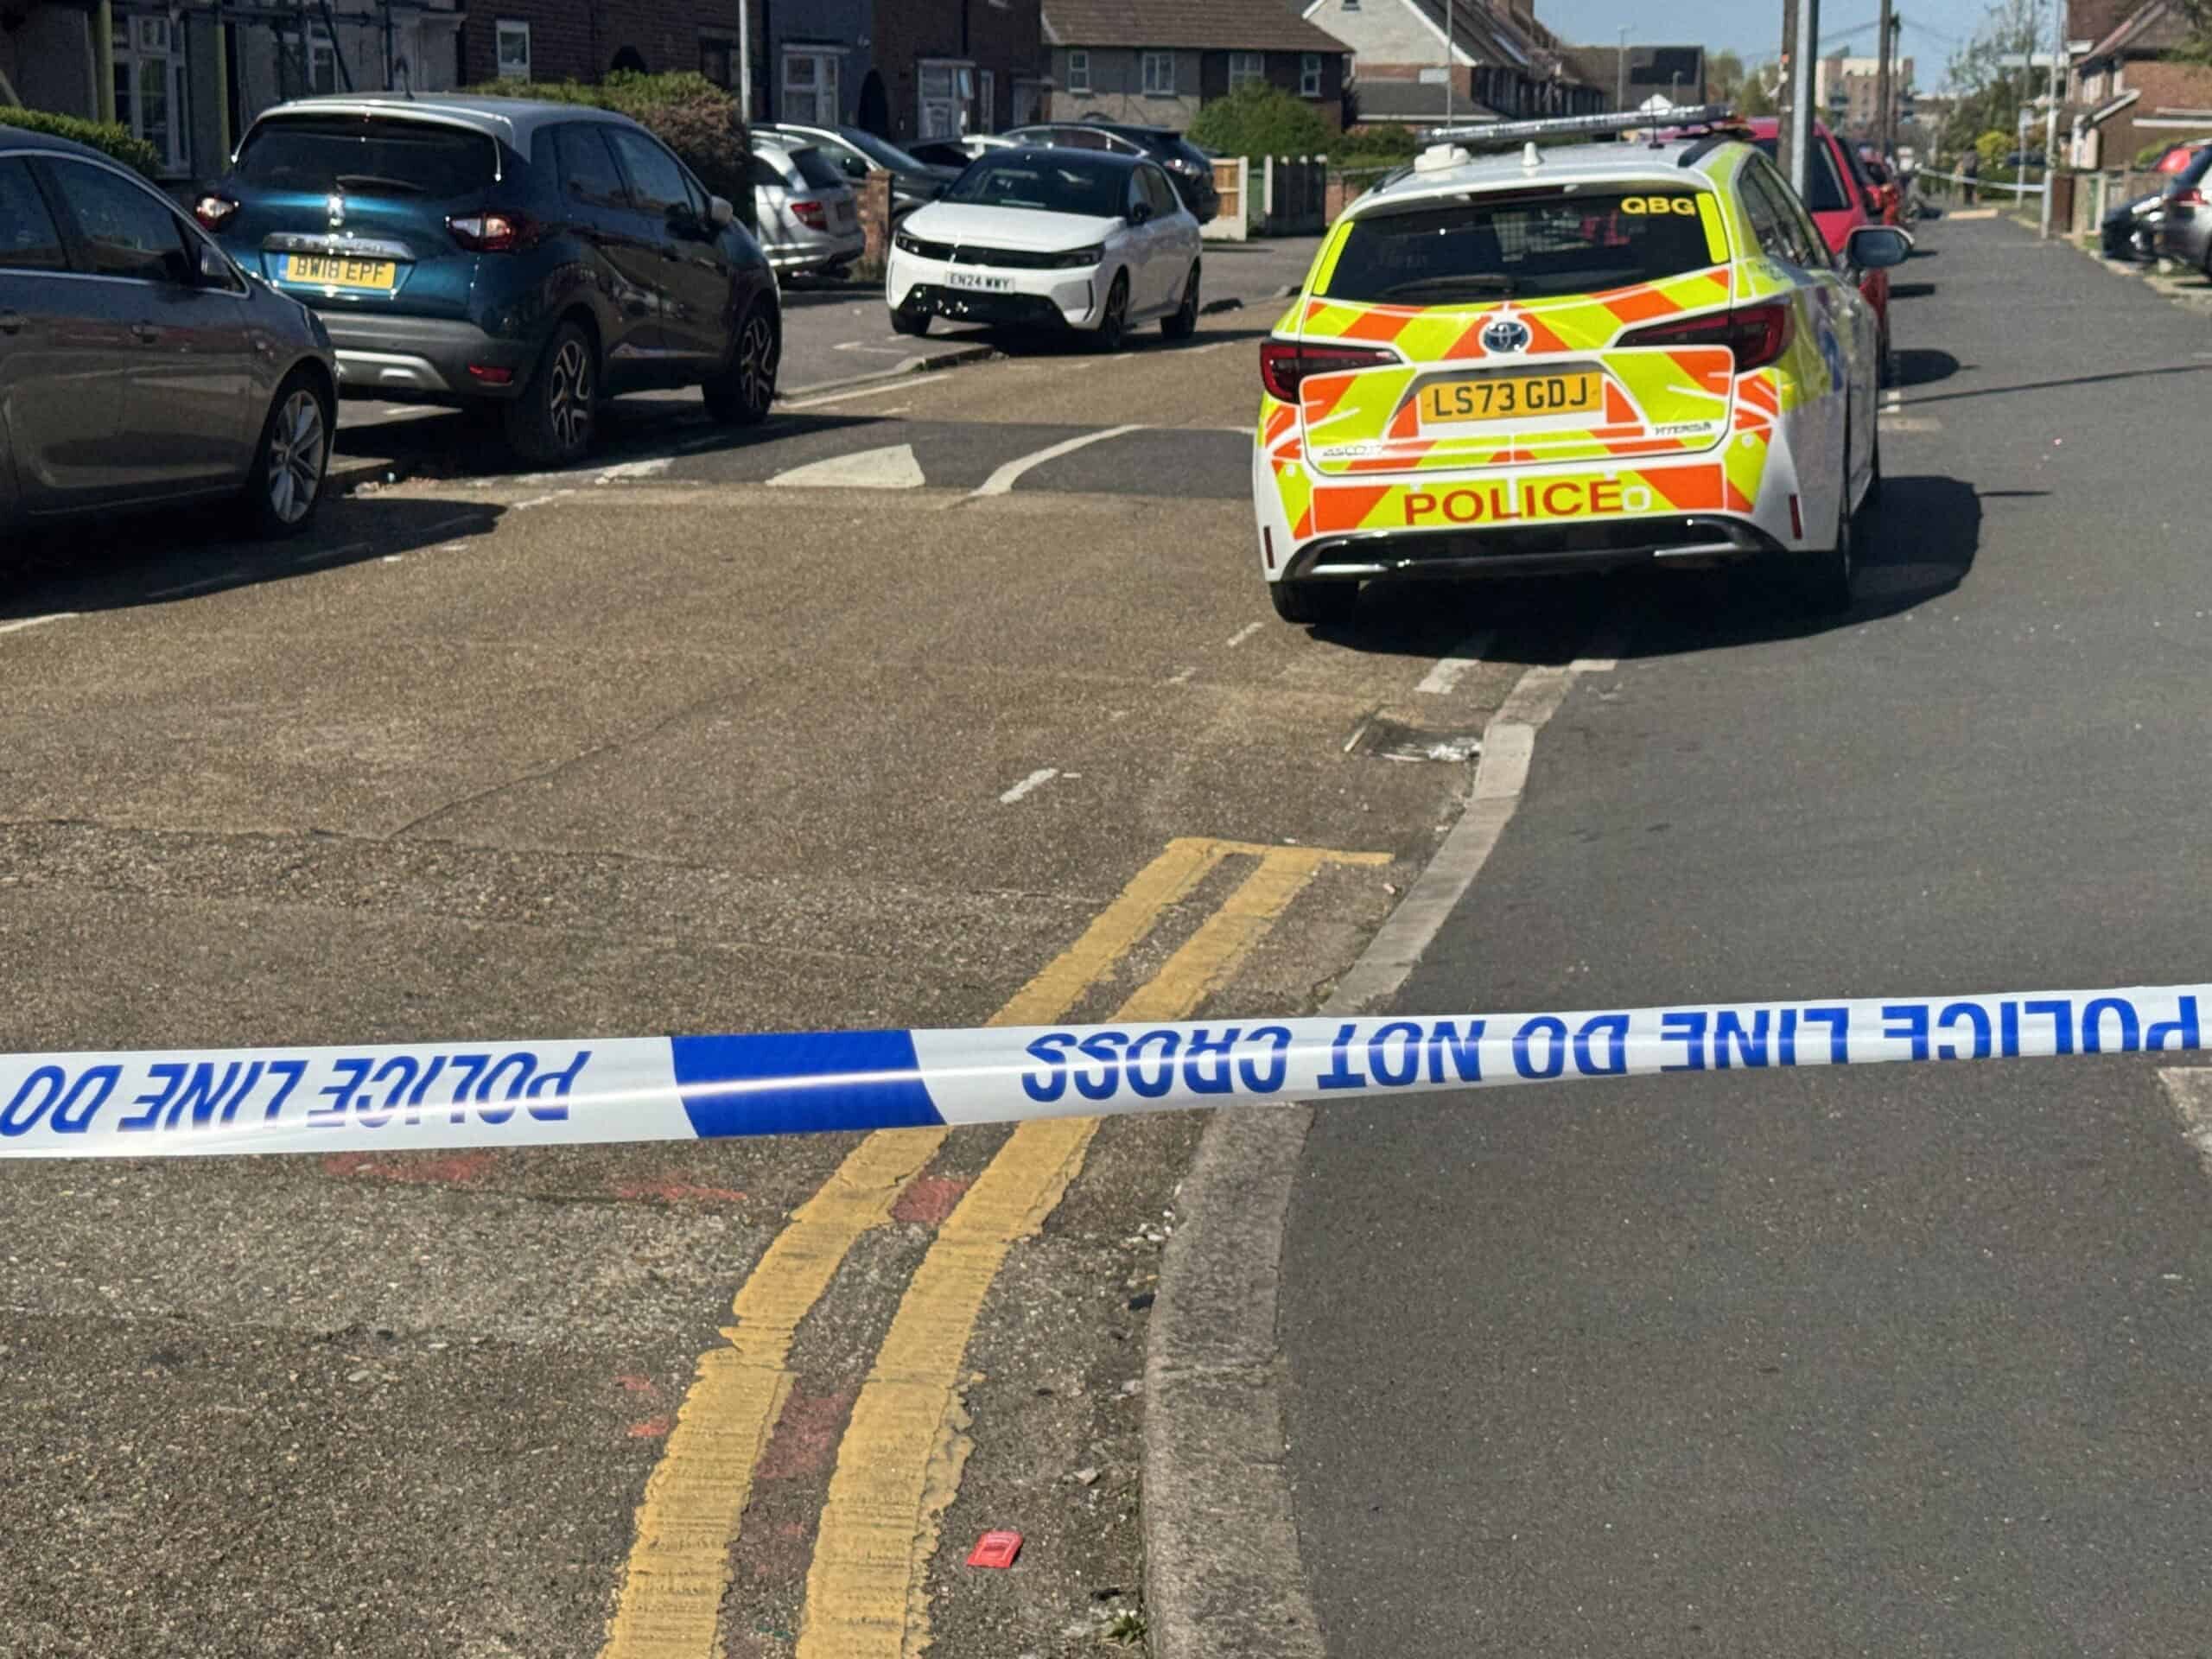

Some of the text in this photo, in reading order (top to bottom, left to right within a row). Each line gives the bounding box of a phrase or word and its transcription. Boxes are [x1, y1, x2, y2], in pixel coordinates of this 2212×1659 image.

[1621, 196, 1696, 216] QBG
[296, 256, 387, 282] BW18 EPF
[1433, 376, 1588, 416] LS73 GDJ
[1404, 479, 1624, 525] POLICE
[1021, 995, 2201, 1103] POLICE LINE DO NOT CROSS
[0, 1051, 592, 1137] POLICE LINE DO
